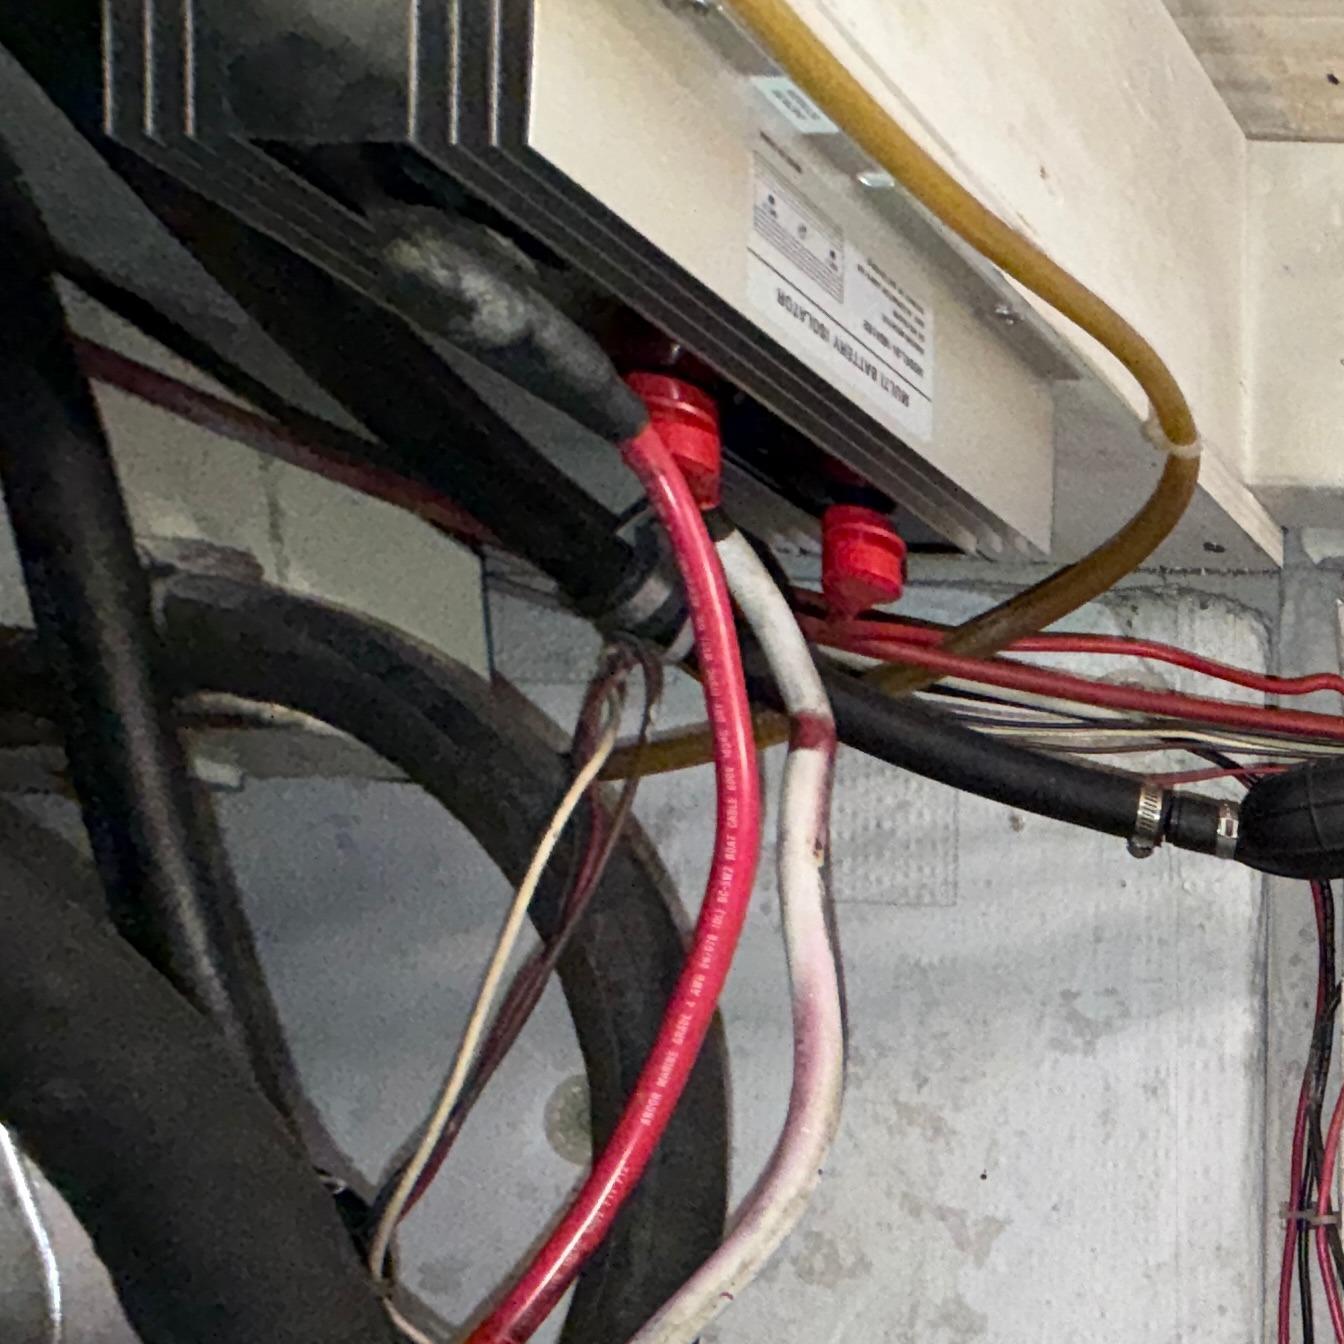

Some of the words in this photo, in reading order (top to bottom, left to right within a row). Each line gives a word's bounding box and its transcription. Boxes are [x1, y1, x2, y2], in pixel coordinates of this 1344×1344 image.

[777, 287, 830, 341] ISOLATOR
[833, 335, 877, 381] BATTERY
[881, 373, 909, 407] MULTI
[726, 798, 738, 828] CABLE
[725, 835, 736, 861] BOAT
[690, 974, 706, 997] AWG
[671, 1014, 693, 1045] GRADE
[656, 1050, 679, 1088] MARINE
[640, 1092, 663, 1126] ANCOR
